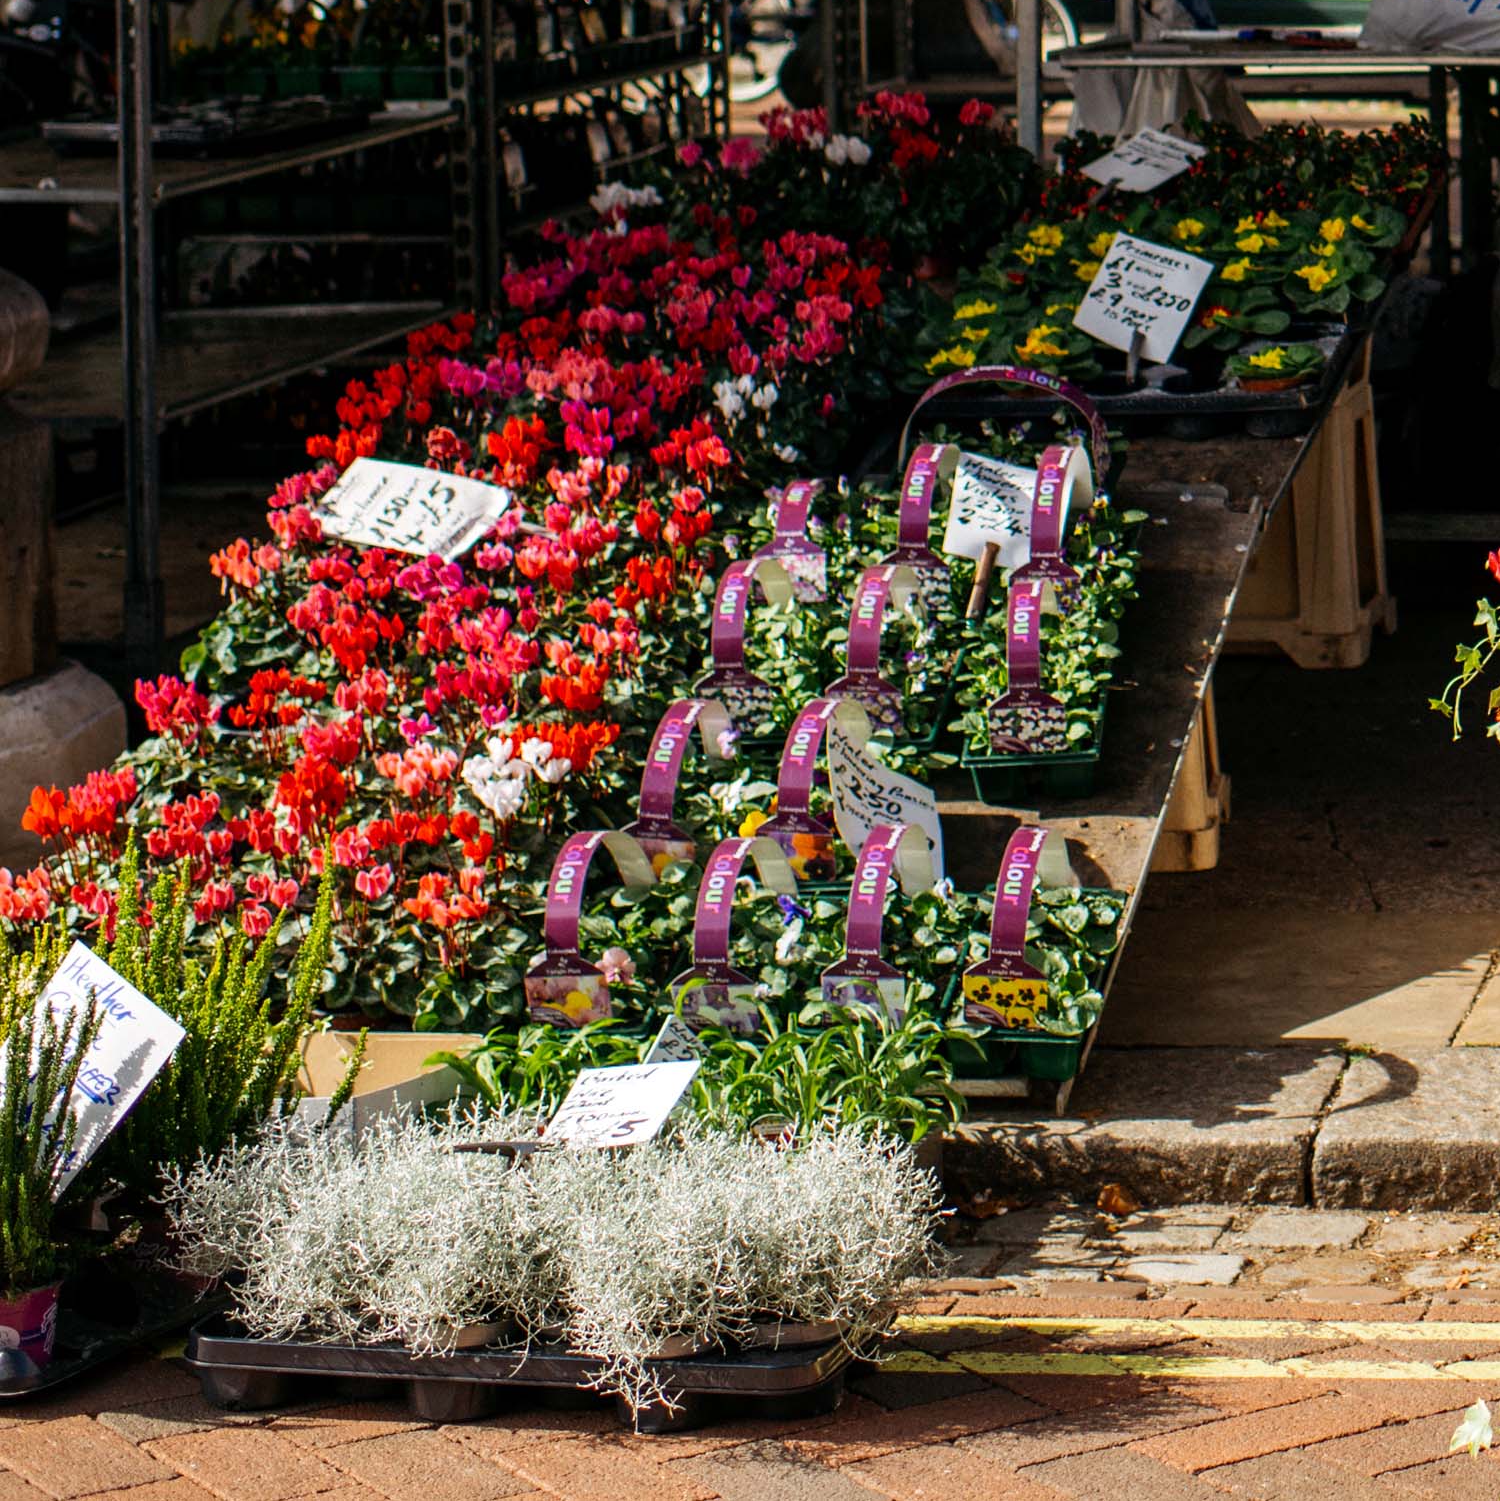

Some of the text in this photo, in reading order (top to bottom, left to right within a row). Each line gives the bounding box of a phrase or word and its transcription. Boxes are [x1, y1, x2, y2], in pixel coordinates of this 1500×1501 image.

[1104, 272, 1123, 288] 3
[907, 458, 932, 506] colour
[1038, 463, 1061, 515] colour
[719, 571, 745, 624] colour
[858, 576, 884, 628] colour
[1013, 593, 1036, 644] colour
[653, 717, 684, 773] colour
[790, 714, 819, 766] colour
[554, 843, 585, 904] colour
[704, 853, 736, 915] colour
[857, 843, 888, 906] colour
[1001, 846, 1033, 906] colour
[61, 955, 137, 1022] Heather
